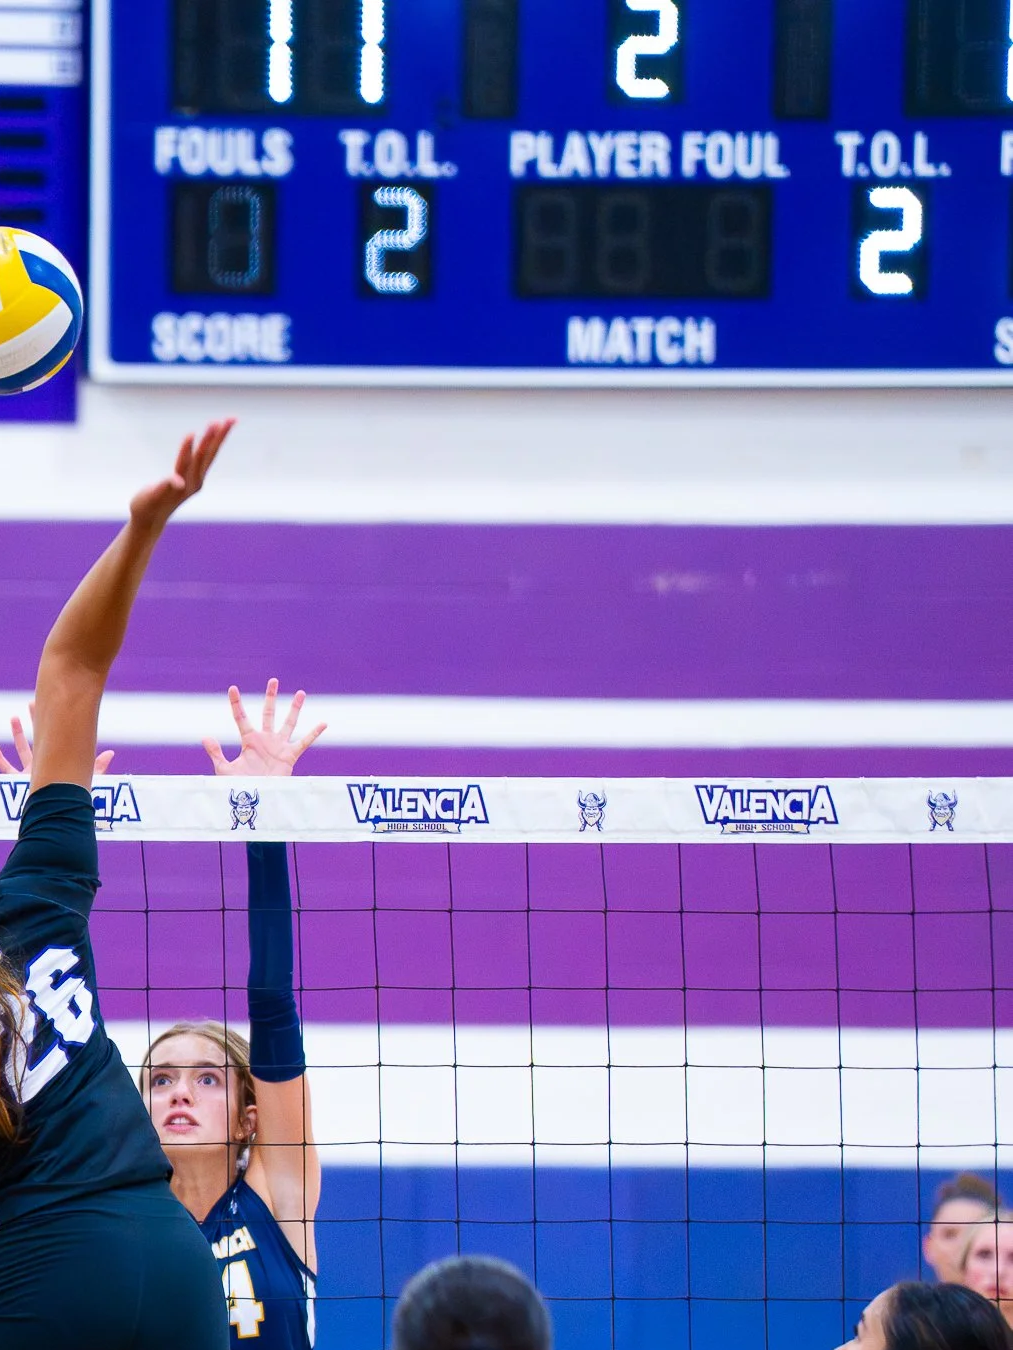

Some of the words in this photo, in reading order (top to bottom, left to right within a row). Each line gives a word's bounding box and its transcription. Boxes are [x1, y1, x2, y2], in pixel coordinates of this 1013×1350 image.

[615, 0, 679, 98] 2
[154, 126, 293, 176] FOULS
[338, 129, 458, 178] T.O.L.
[509, 130, 672, 178] PLAYER
[682, 131, 790, 178] FOUL
[834, 131, 952, 178] T.O.L.
[365, 186, 428, 293] 2
[859, 186, 923, 294] 2
[152, 311, 292, 362] SCORE
[567, 316, 716, 365] MATCH
[346, 784, 489, 824] VALENCIA
[387, 822, 408, 830] HIGH
[412, 822, 446, 830] SCHOOL
[695, 785, 838, 824] VALENCIA
[735, 823, 757, 831] HIGH
[761, 823, 794, 831] SCHOOL
[221, 1259, 265, 1339] 4
